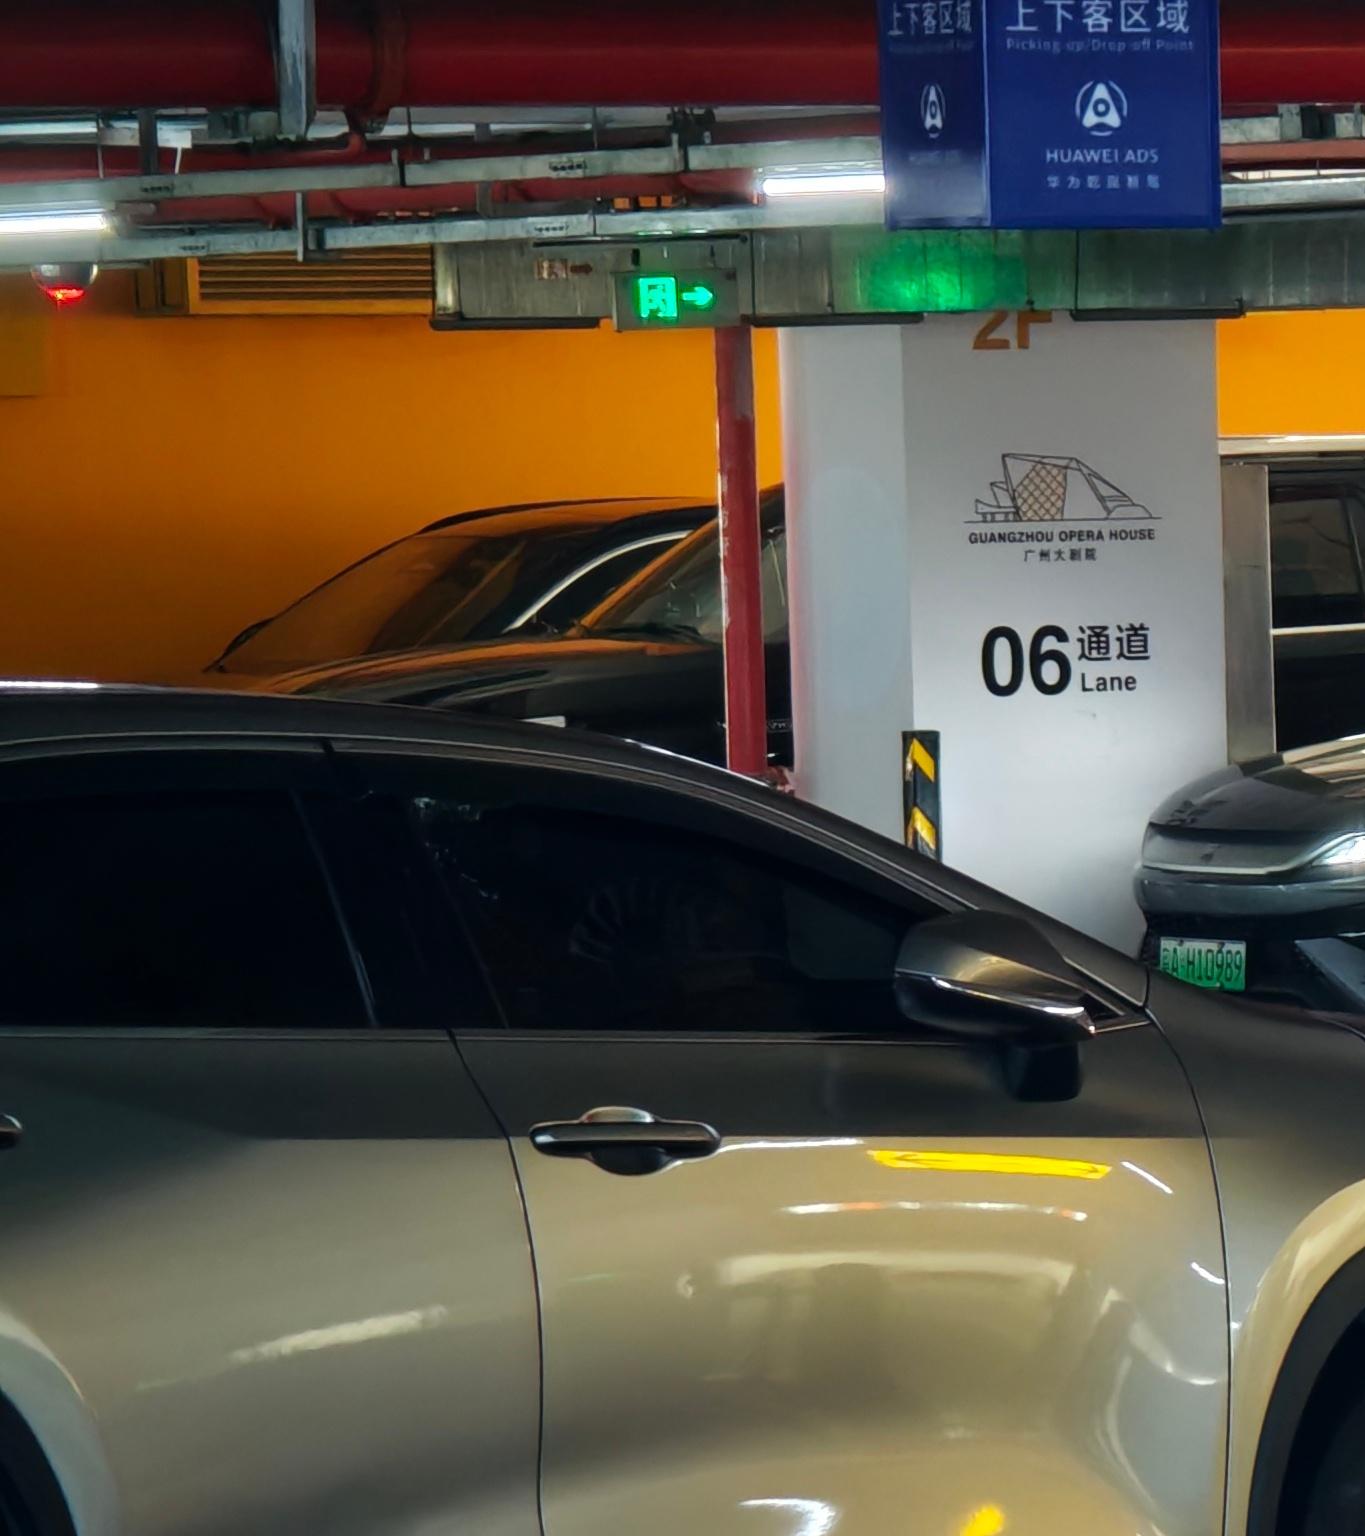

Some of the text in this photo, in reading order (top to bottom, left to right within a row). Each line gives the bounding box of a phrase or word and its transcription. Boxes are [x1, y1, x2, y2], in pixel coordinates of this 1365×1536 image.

[1006, 0, 1190, 33] 上下客区域
[1046, 148, 1159, 163] HUAWEI ADS
[968, 528, 1156, 544] GUANGZHOU OPERA HOUSE
[1024, 548, 1098, 563] 广州大剧院
[982, 623, 1151, 697] 06 通道
[1081, 673, 1137, 692] Lane
